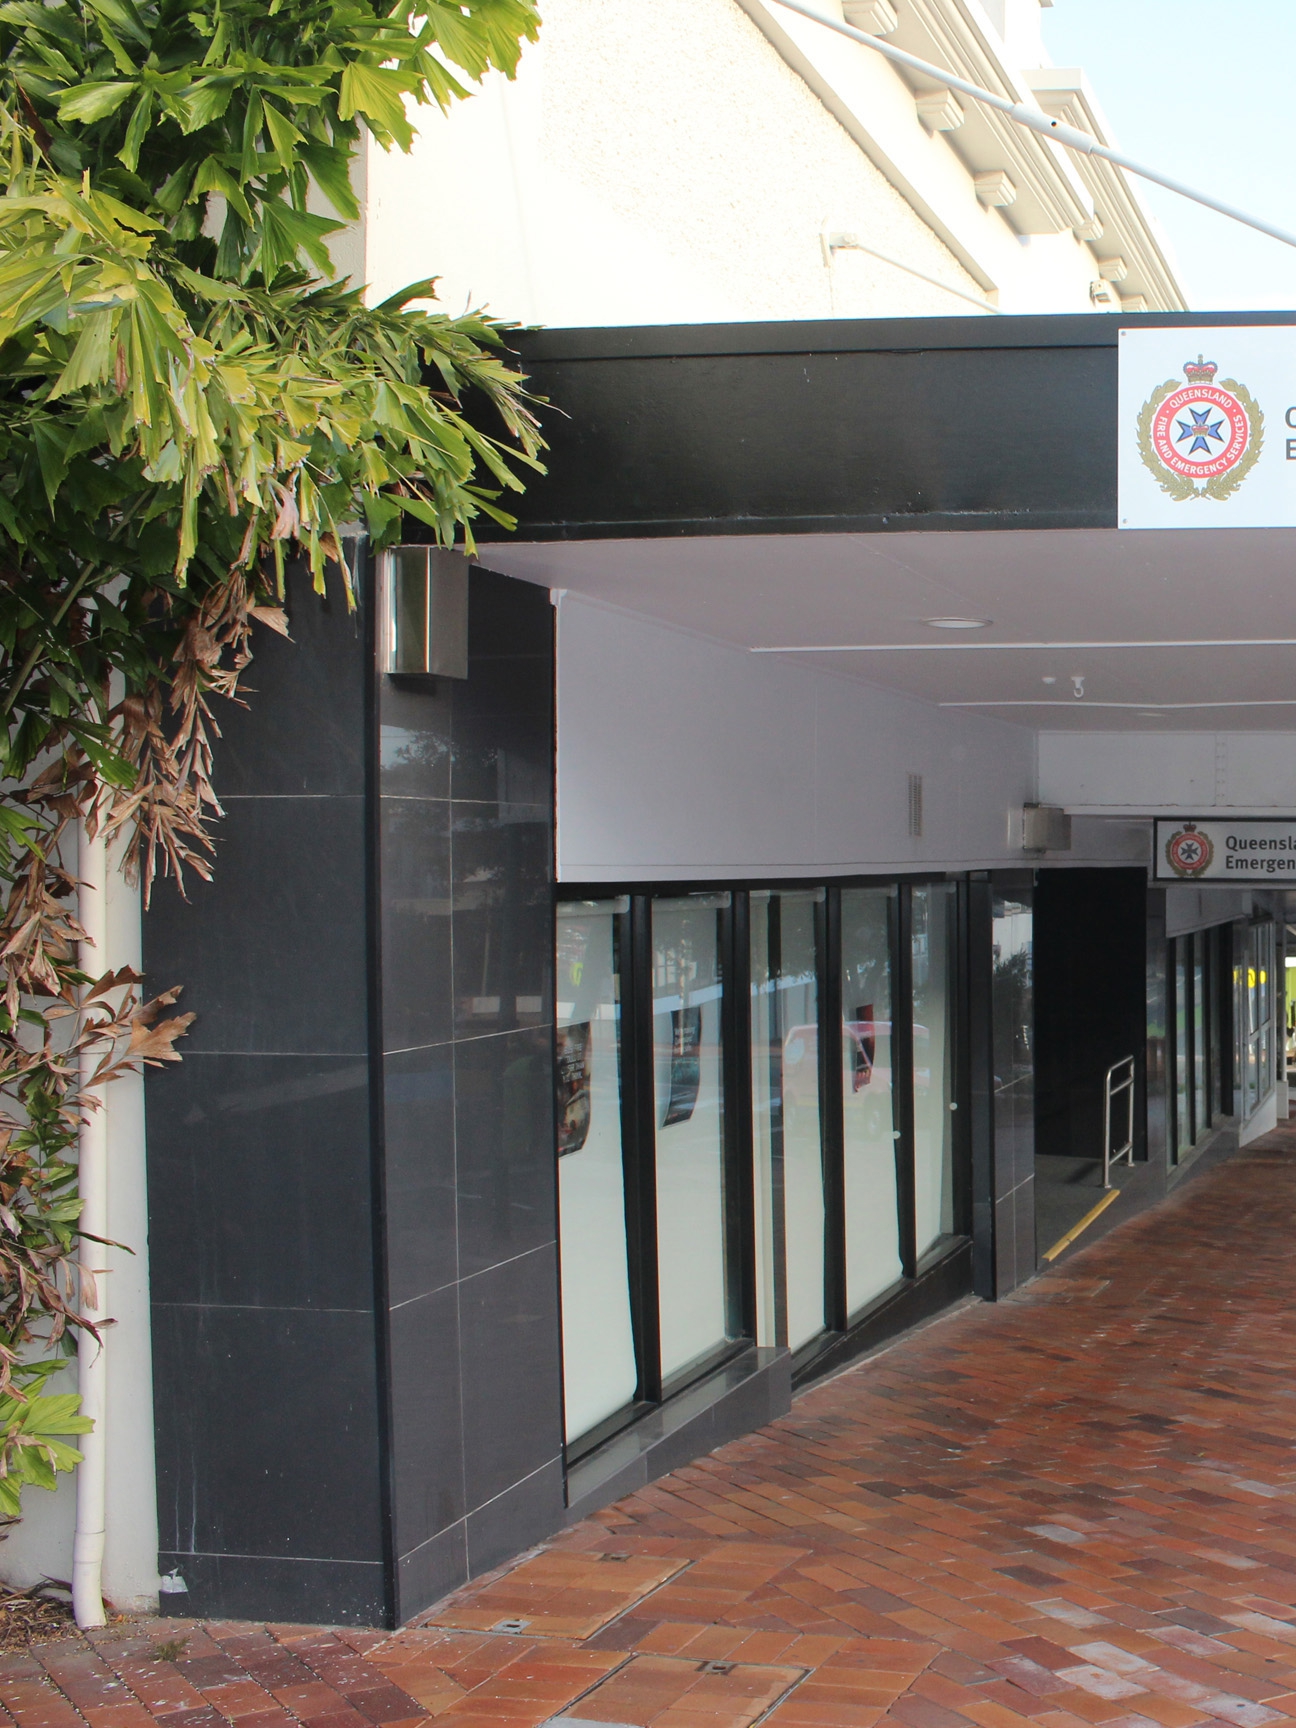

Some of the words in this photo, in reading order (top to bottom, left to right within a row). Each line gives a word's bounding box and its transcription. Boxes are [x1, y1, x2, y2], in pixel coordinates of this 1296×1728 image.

[1169, 388, 1233, 409] QUEENSLAND
[1157, 416, 1168, 437] FIRE
[1226, 414, 1245, 461] SERVICES
[1157, 439, 1173, 459] AND
[1171, 457, 1228, 475] EMERGENCY
